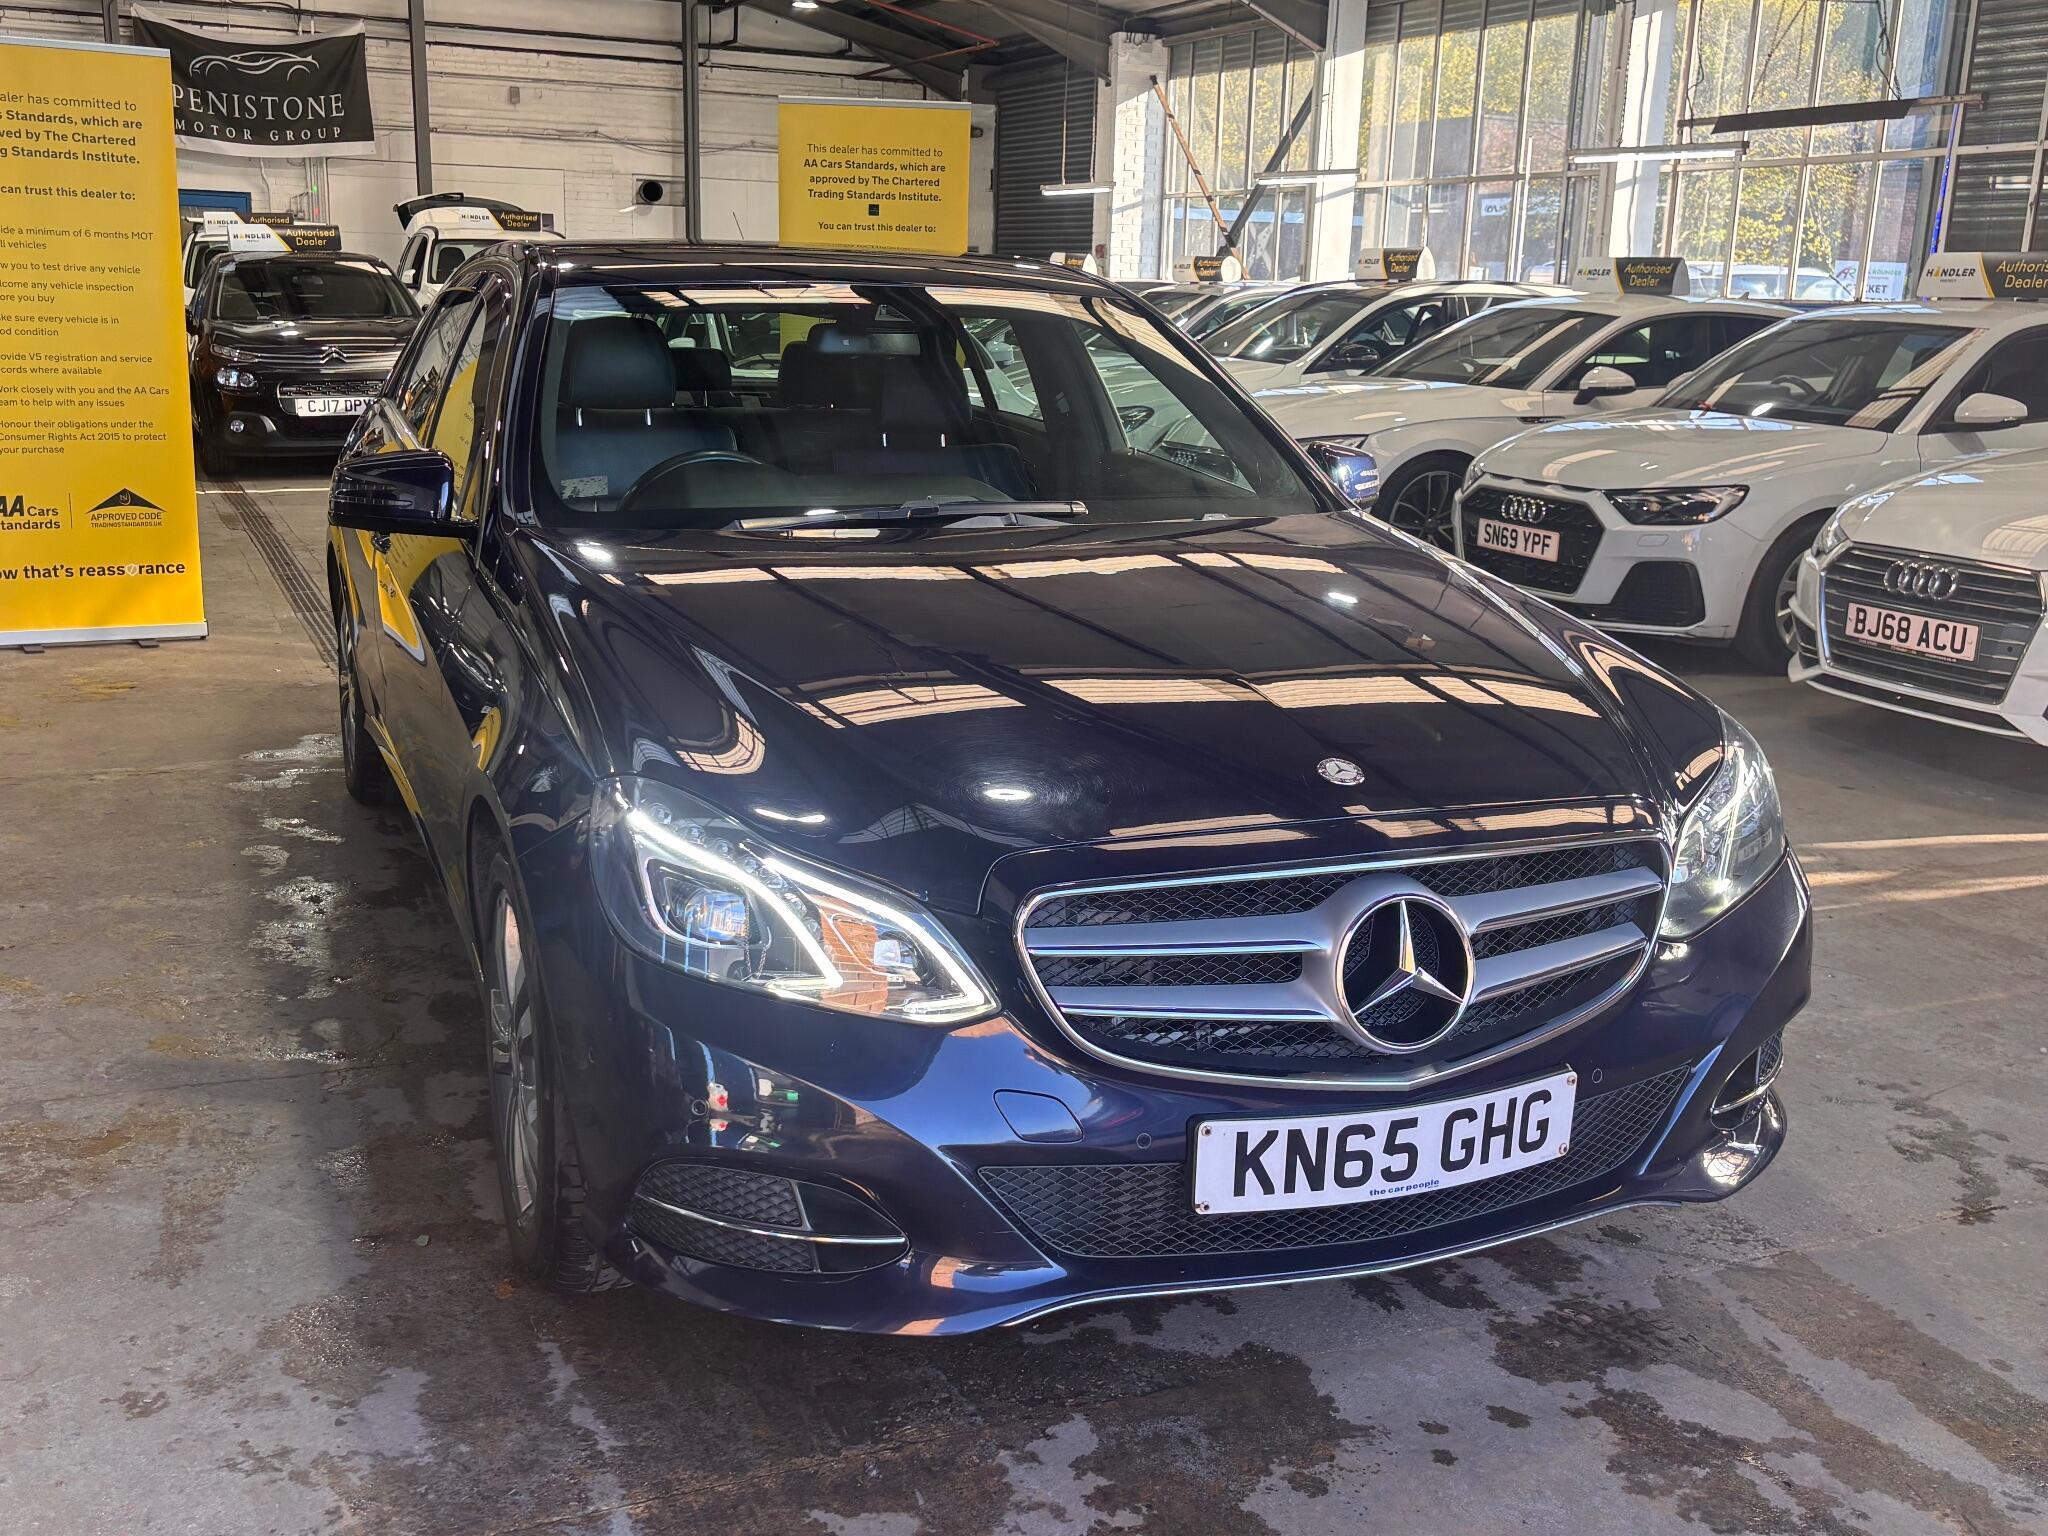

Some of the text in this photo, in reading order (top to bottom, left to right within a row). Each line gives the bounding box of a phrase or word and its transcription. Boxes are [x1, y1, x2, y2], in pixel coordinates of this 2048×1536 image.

[27, 92, 50, 105] has
[53, 97, 121, 111] committed
[125, 100, 137, 112] to
[171, 83, 345, 121] PENISTONE
[6, 110, 78, 126] Standards,
[81, 116, 119, 128] which
[122, 120, 143, 129] are
[175, 118, 341, 142] MOTOR GROUP
[26, 129, 41, 142] by
[44, 130, 69, 142] The
[72, 132, 136, 146] Chartered
[11, 146, 79, 160] Standards
[82, 150, 140, 164] Institute.
[807, 143, 943, 157] This dealer has committed to
[803, 159, 818, 168] AA
[820, 160, 843, 169] Cars
[844, 160, 898, 172] Standards,
[900, 162, 928, 172] which
[809, 175, 940, 187] approved by The Chartered
[0, 185, 136, 200] can trust this dealer to:
[808, 189, 942, 202] Trading Standards Institute.
[249, 216, 290, 225] Authorised
[500, 211, 538, 221] Authorised
[507, 219, 531, 228] Dealer
[818, 222, 937, 233] You can trust this dealer to:
[26, 227, 70, 237] minimum
[73, 229, 82, 237] of
[84, 229, 92, 238] 6
[94, 231, 129, 240] months
[131, 231, 154, 241] MOT
[286, 228, 335, 238] Authorised
[8, 240, 47, 250] vehicles
[296, 238, 327, 246] Dealer
[11, 263, 28, 271] you
[30, 262, 40, 270] to
[43, 262, 61, 271] test
[63, 263, 87, 272] drive
[89, 265, 106, 274] any
[108, 265, 141, 274] vehicle
[1624, 262, 1673, 274] Authorised
[31, 283, 48, 291] any
[50, 281, 83, 290] vehicle
[85, 282, 134, 293] inspection
[1629, 275, 1660, 287] Dealer
[2005, 274, 2048, 288] Dealer
[17, 295, 35, 303] you
[37, 292, 55, 304] buy
[0, 313, 120, 325] ke sure every vehicle is in
[14, 327, 59, 336] condition
[28, 352, 42, 361] V5
[44, 353, 98, 363] registration
[100, 354, 117, 362] and
[119, 354, 153, 363] service
[29, 365, 59, 374] where
[61, 366, 103, 375] available
[21, 385, 54, 395] closely
[56, 385, 77, 394] with
[79, 387, 96, 396] you
[97, 386, 115, 394] and
[117, 386, 132, 395] the
[133, 386, 147, 395] AA
[149, 386, 170, 395] Cars
[20, 398, 31, 407] to
[32, 397, 53, 408] help
[55, 398, 76, 407] with
[78, 399, 95, 409] any
[96, 398, 125, 407] issues
[307, 400, 339, 413] CJ17
[33, 420, 55, 429] their
[57, 420, 109, 430] obligations
[110, 420, 137, 429] under
[138, 420, 154, 429] the
[48, 432, 78, 443] Rights
[80, 432, 96, 441] Act
[97, 432, 121, 441] 2015
[122, 432, 132, 441] to
[133, 432, 167, 442] protect
[21, 445, 65, 455] purchase
[27, 506, 59, 517] Cars
[90, 511, 163, 521] APPROVED CODE
[1484, 523, 1552, 556] SN69 YPF
[23, 564, 74, 578] that's
[1853, 606, 1911, 643] BJ68
[1916, 619, 1968, 655] ACU
[1234, 1089, 1552, 1197] KN65 GHG
